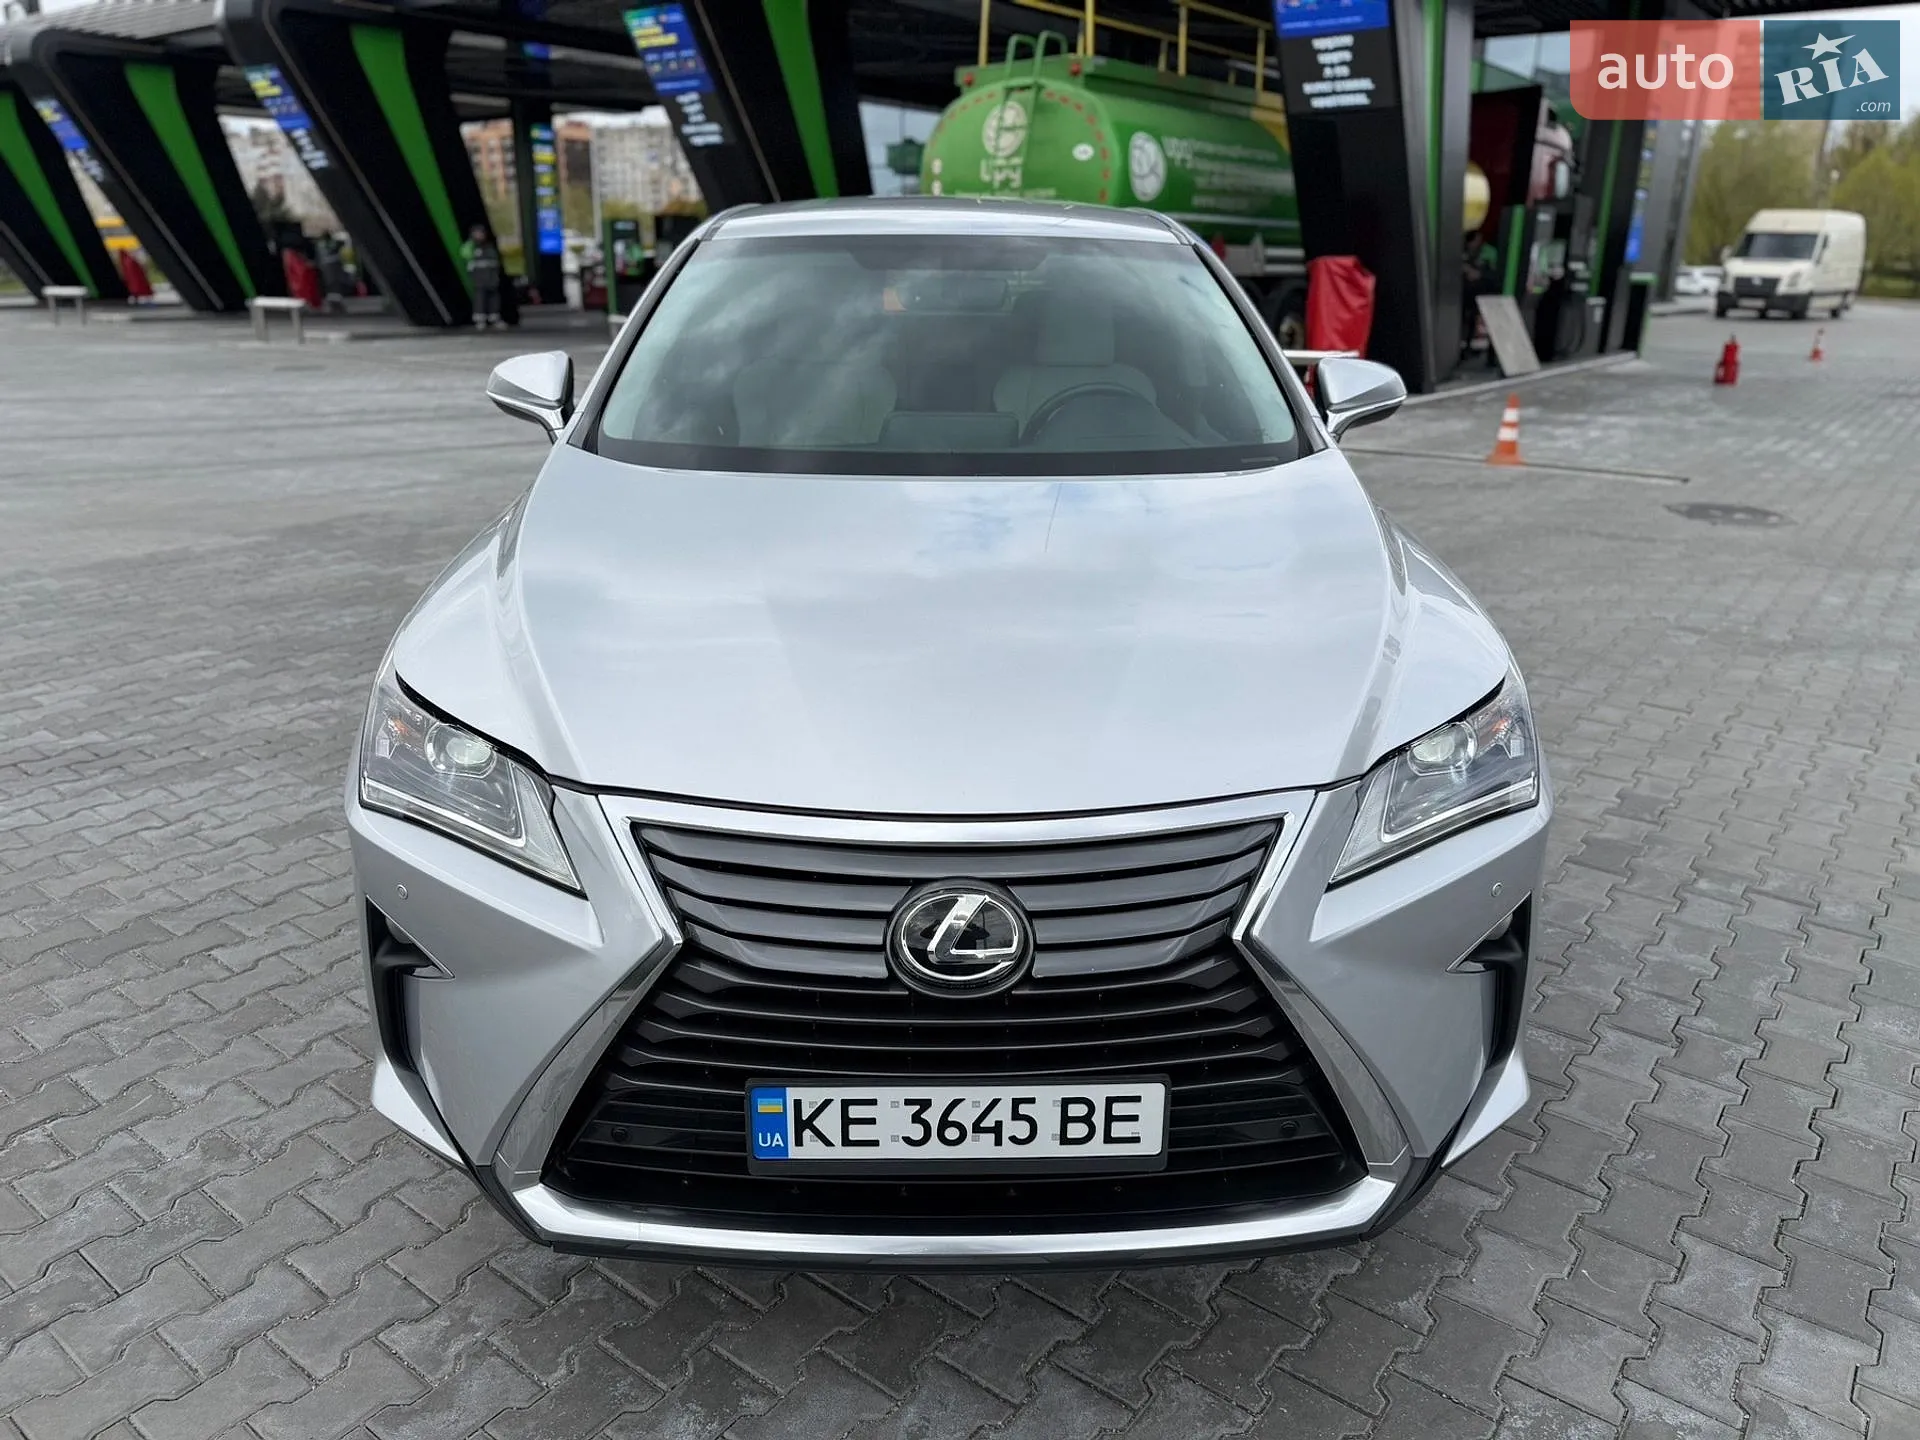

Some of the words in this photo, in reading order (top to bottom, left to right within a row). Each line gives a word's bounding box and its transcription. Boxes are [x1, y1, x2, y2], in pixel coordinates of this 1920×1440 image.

[793, 1097, 880, 1148] KE
[900, 1096, 1039, 1147] 3645
[1058, 1095, 1143, 1146] BE
[758, 1132, 785, 1148] UA
